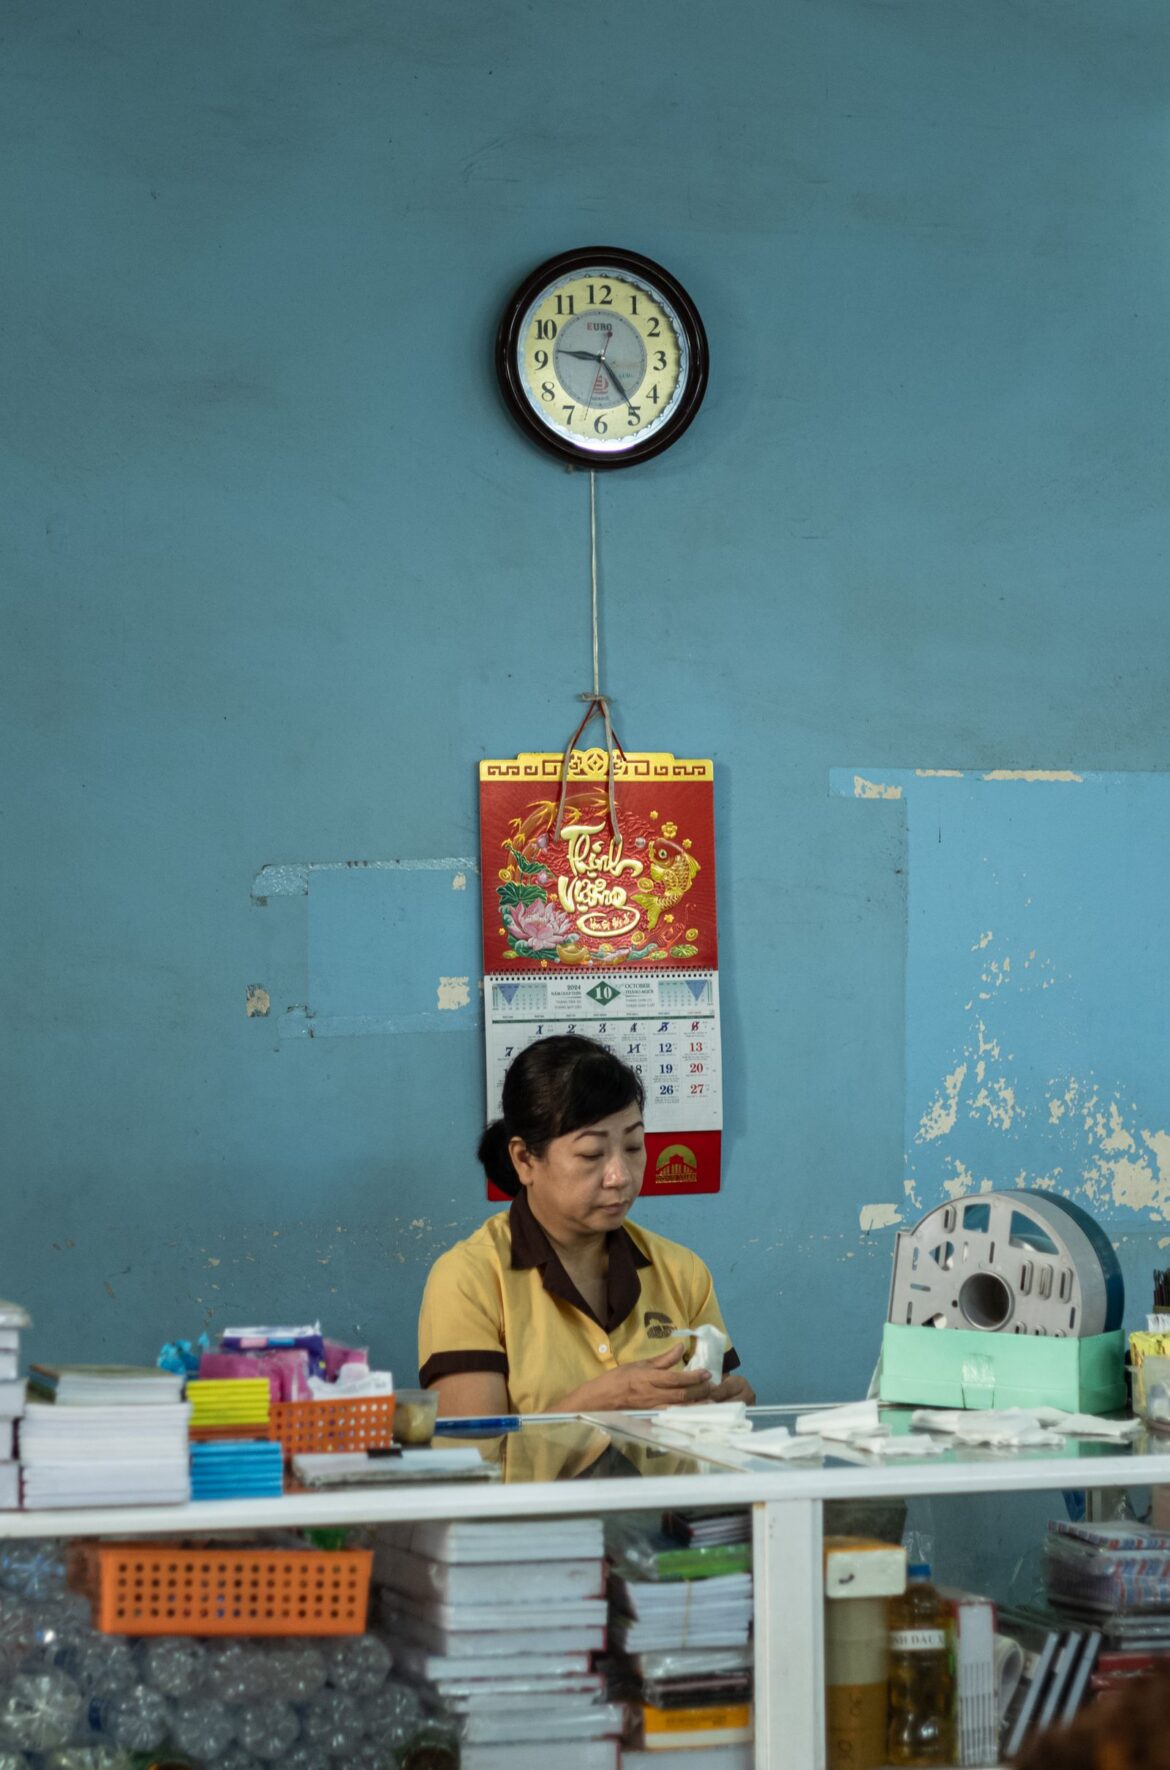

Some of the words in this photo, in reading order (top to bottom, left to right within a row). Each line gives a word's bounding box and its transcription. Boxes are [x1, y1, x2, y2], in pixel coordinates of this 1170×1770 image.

[555, 294, 576, 315] 11
[586, 284, 613, 305] 12
[629, 295, 639, 315] 1
[534, 318, 558, 340] 10
[586, 322, 613, 332] EURO
[646, 317, 661, 338] 2
[534, 350, 549, 371] 9
[652, 351, 668, 372] 3
[541, 382, 556, 402] 8
[646, 384, 661, 405] 4
[562, 405, 576, 425] 7
[594, 414, 608, 434] 6
[627, 406, 641, 426] 5
[560, 821, 643, 878] Thịnh
[595, 986, 613, 1000] 10
[659, 1042, 673, 1053] 12
[690, 1042, 703, 1053] 13
[660, 1064, 673, 1074] 19
[690, 1063, 704, 1074] 20
[660, 1085, 674, 1095] 26
[690, 1084, 704, 1095] 27
